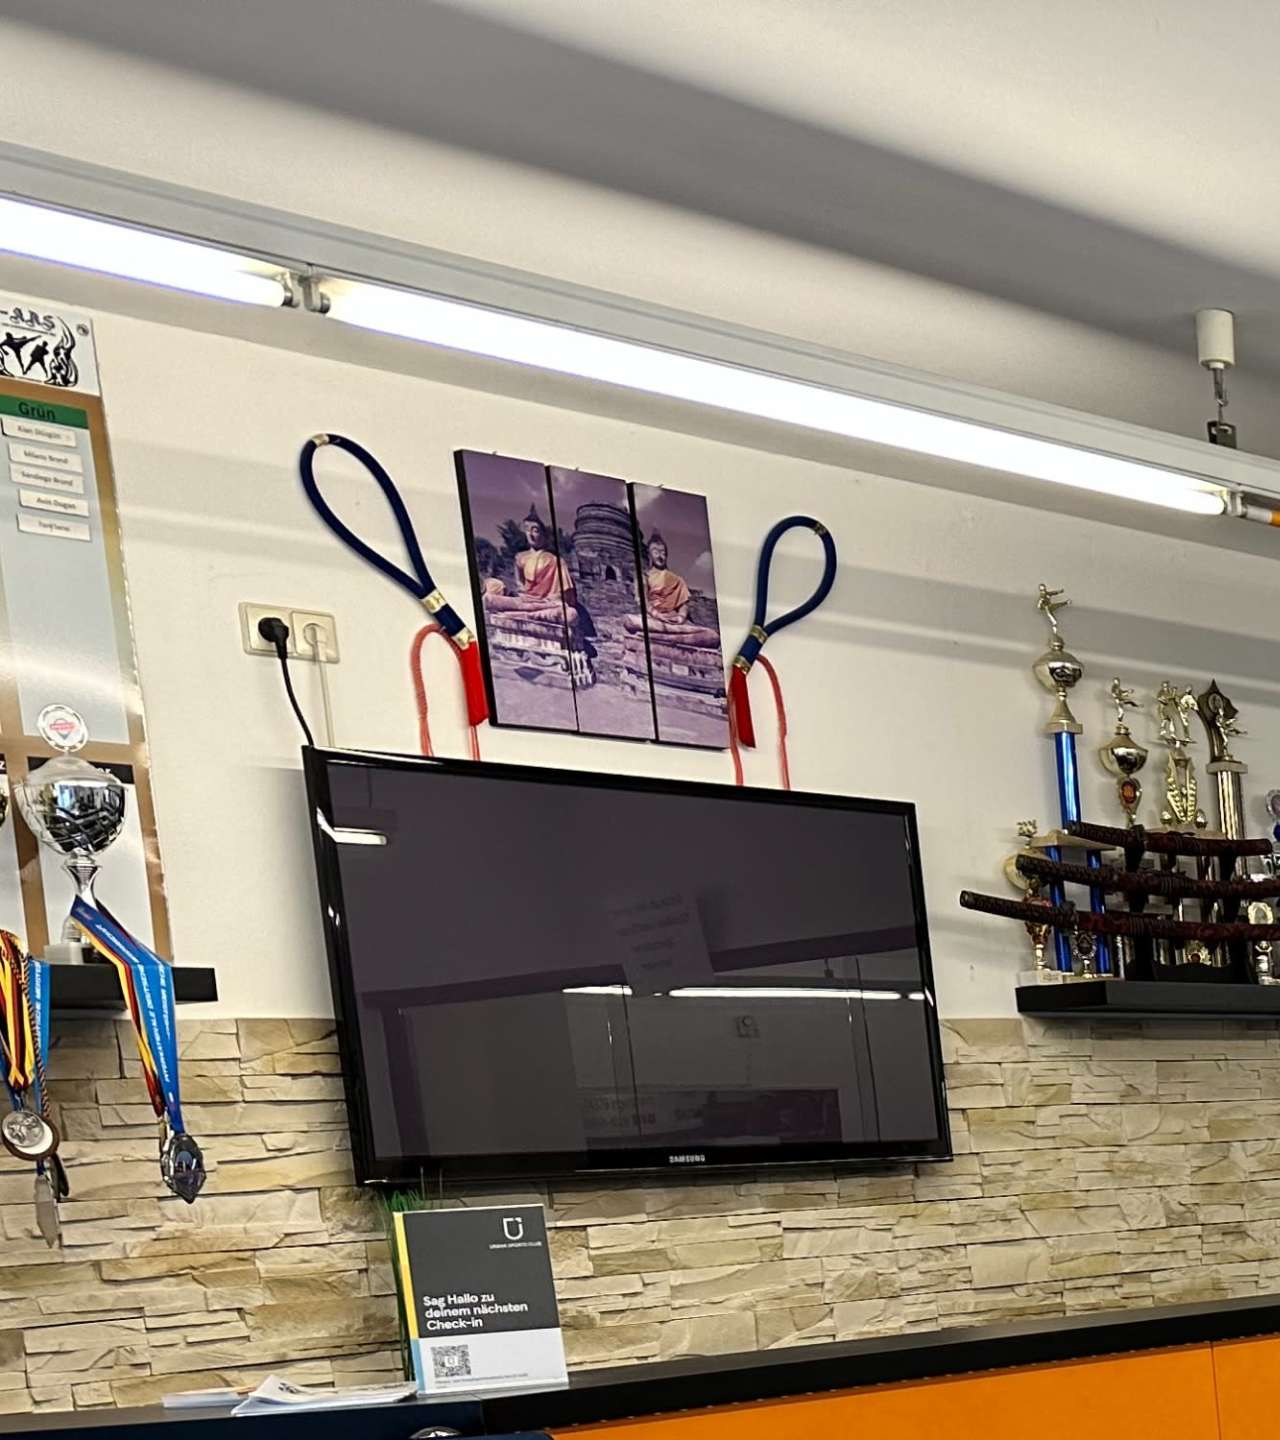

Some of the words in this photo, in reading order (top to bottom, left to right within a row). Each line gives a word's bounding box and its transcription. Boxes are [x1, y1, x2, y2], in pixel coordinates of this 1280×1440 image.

[669, 1155, 705, 1163] SAMSUNG
[423, 1296, 446, 1307] Sag
[447, 1293, 478, 1305] Hallo
[480, 1293, 495, 1303] zu
[425, 1306, 471, 1318] deinem
[473, 1302, 528, 1315] nächsten
[426, 1317, 483, 1330] Check-in
